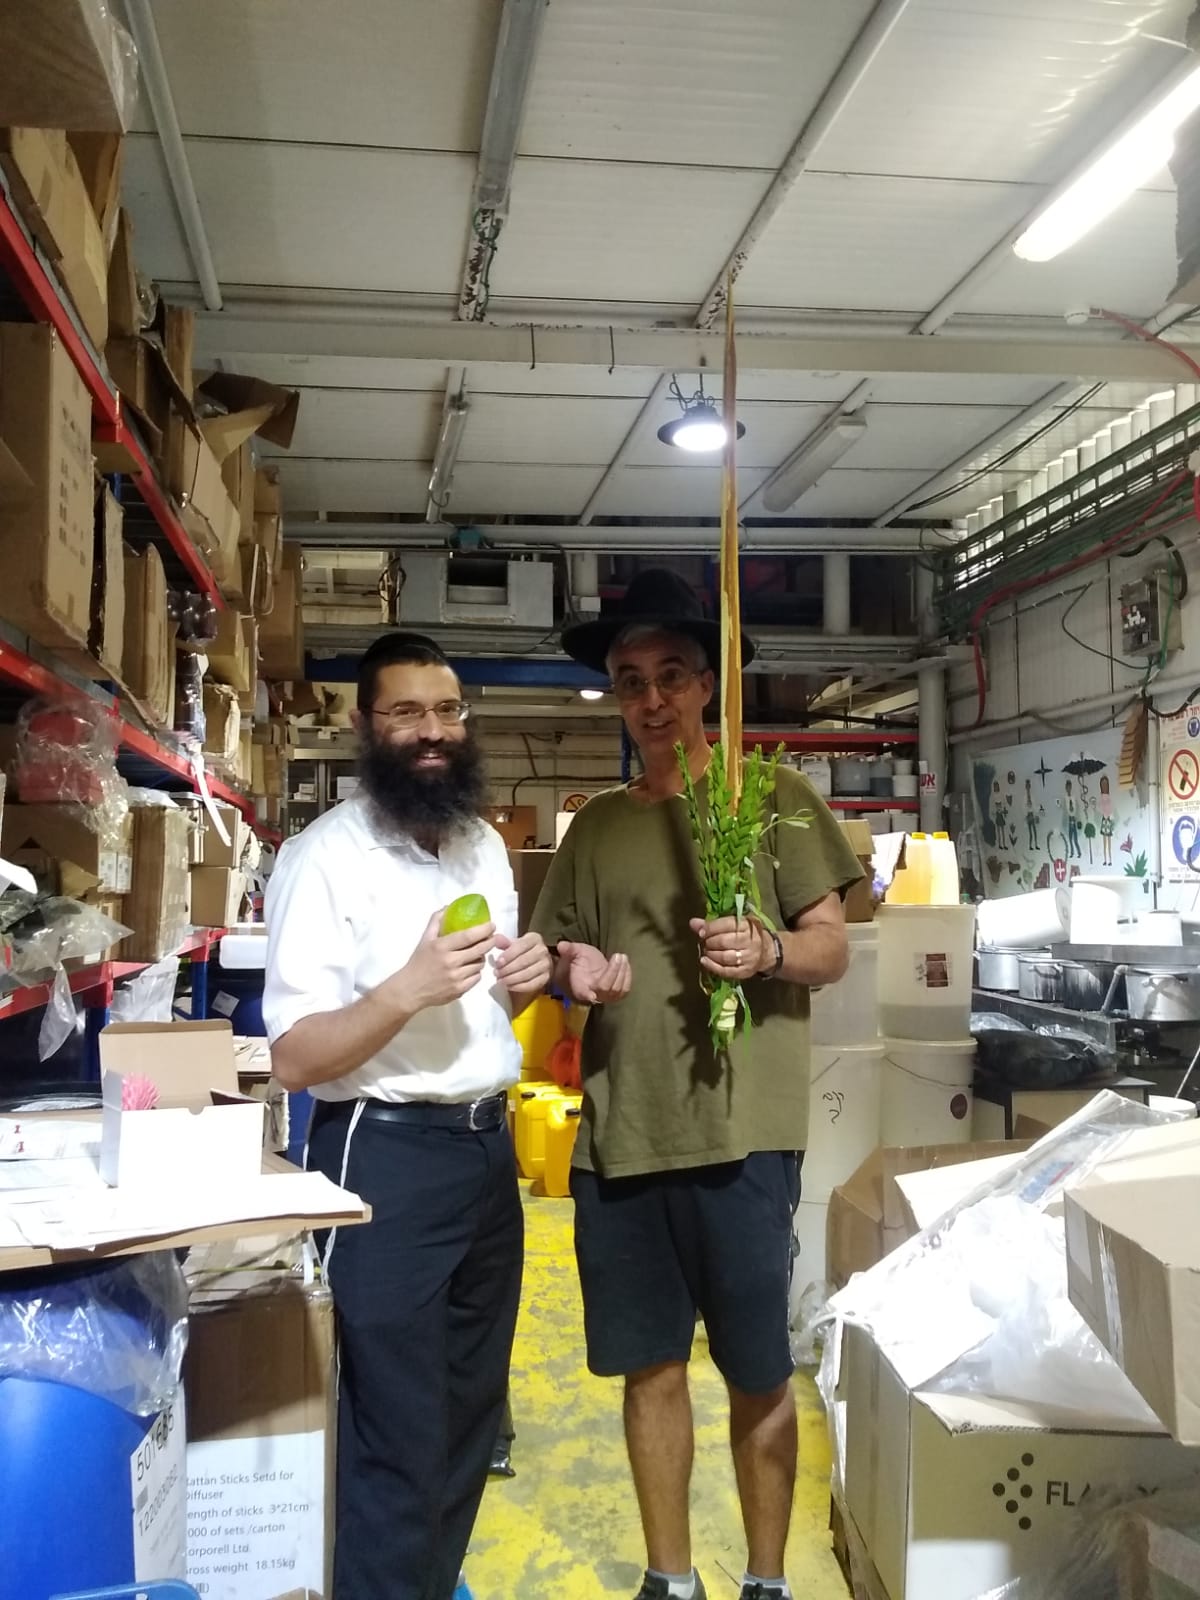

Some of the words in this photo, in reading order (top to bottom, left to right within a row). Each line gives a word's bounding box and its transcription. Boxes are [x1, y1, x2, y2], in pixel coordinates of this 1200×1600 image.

[220, 1474, 250, 1484] Sticks
[280, 1469, 294, 1480] for
[187, 1508, 218, 1521] ength
[221, 1506, 232, 1517] of
[235, 1505, 264, 1517] sticks
[187, 1527, 208, 1537] 000
[210, 1525, 221, 1536] of
[224, 1526, 245, 1536] sets
[187, 1544, 229, 1558] orporell
[186, 1566, 210, 1575] ross
[213, 1562, 248, 1575] weight
